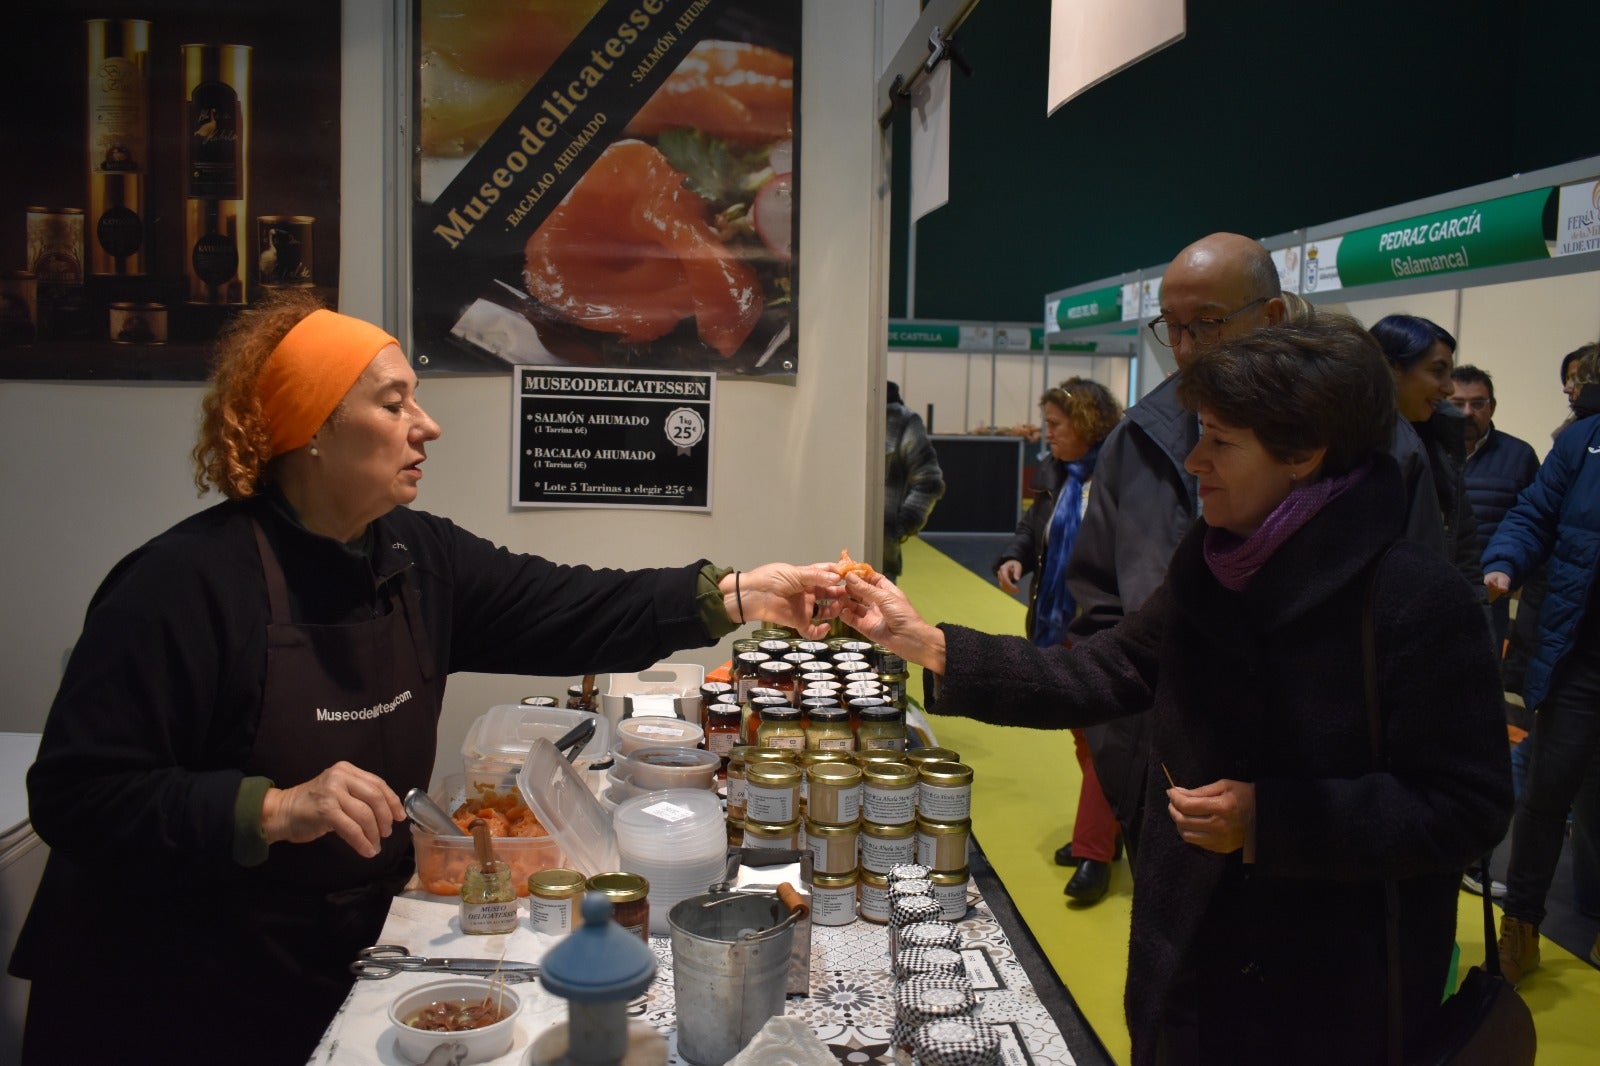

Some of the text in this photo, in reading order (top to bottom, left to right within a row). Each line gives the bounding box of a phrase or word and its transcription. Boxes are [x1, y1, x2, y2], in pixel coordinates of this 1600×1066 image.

[631, 31, 676, 84] SALMÓN
[432, 0, 669, 250] Museodelicatesse
[507, 111, 608, 228] BACALAO AHUMADO
[1379, 209, 1482, 252] PEDRAZ GARCÍA
[1391, 246, 1469, 278] (Salamanca)
[524, 376, 706, 396] MUSEODELICATESSEN
[534, 411, 650, 426] SALMÓN AHUMADO
[545, 426, 573, 435] Tarrina
[534, 448, 656, 461] BACALAO AHUMADO
[544, 461, 572, 469] Tarrina
[543, 481, 567, 492] Lote
[570, 482, 577, 491] 5
[580, 482, 622, 494] Tarrinas
[634, 485, 663, 496] elegir
[665, 485, 685, 495] 25€
